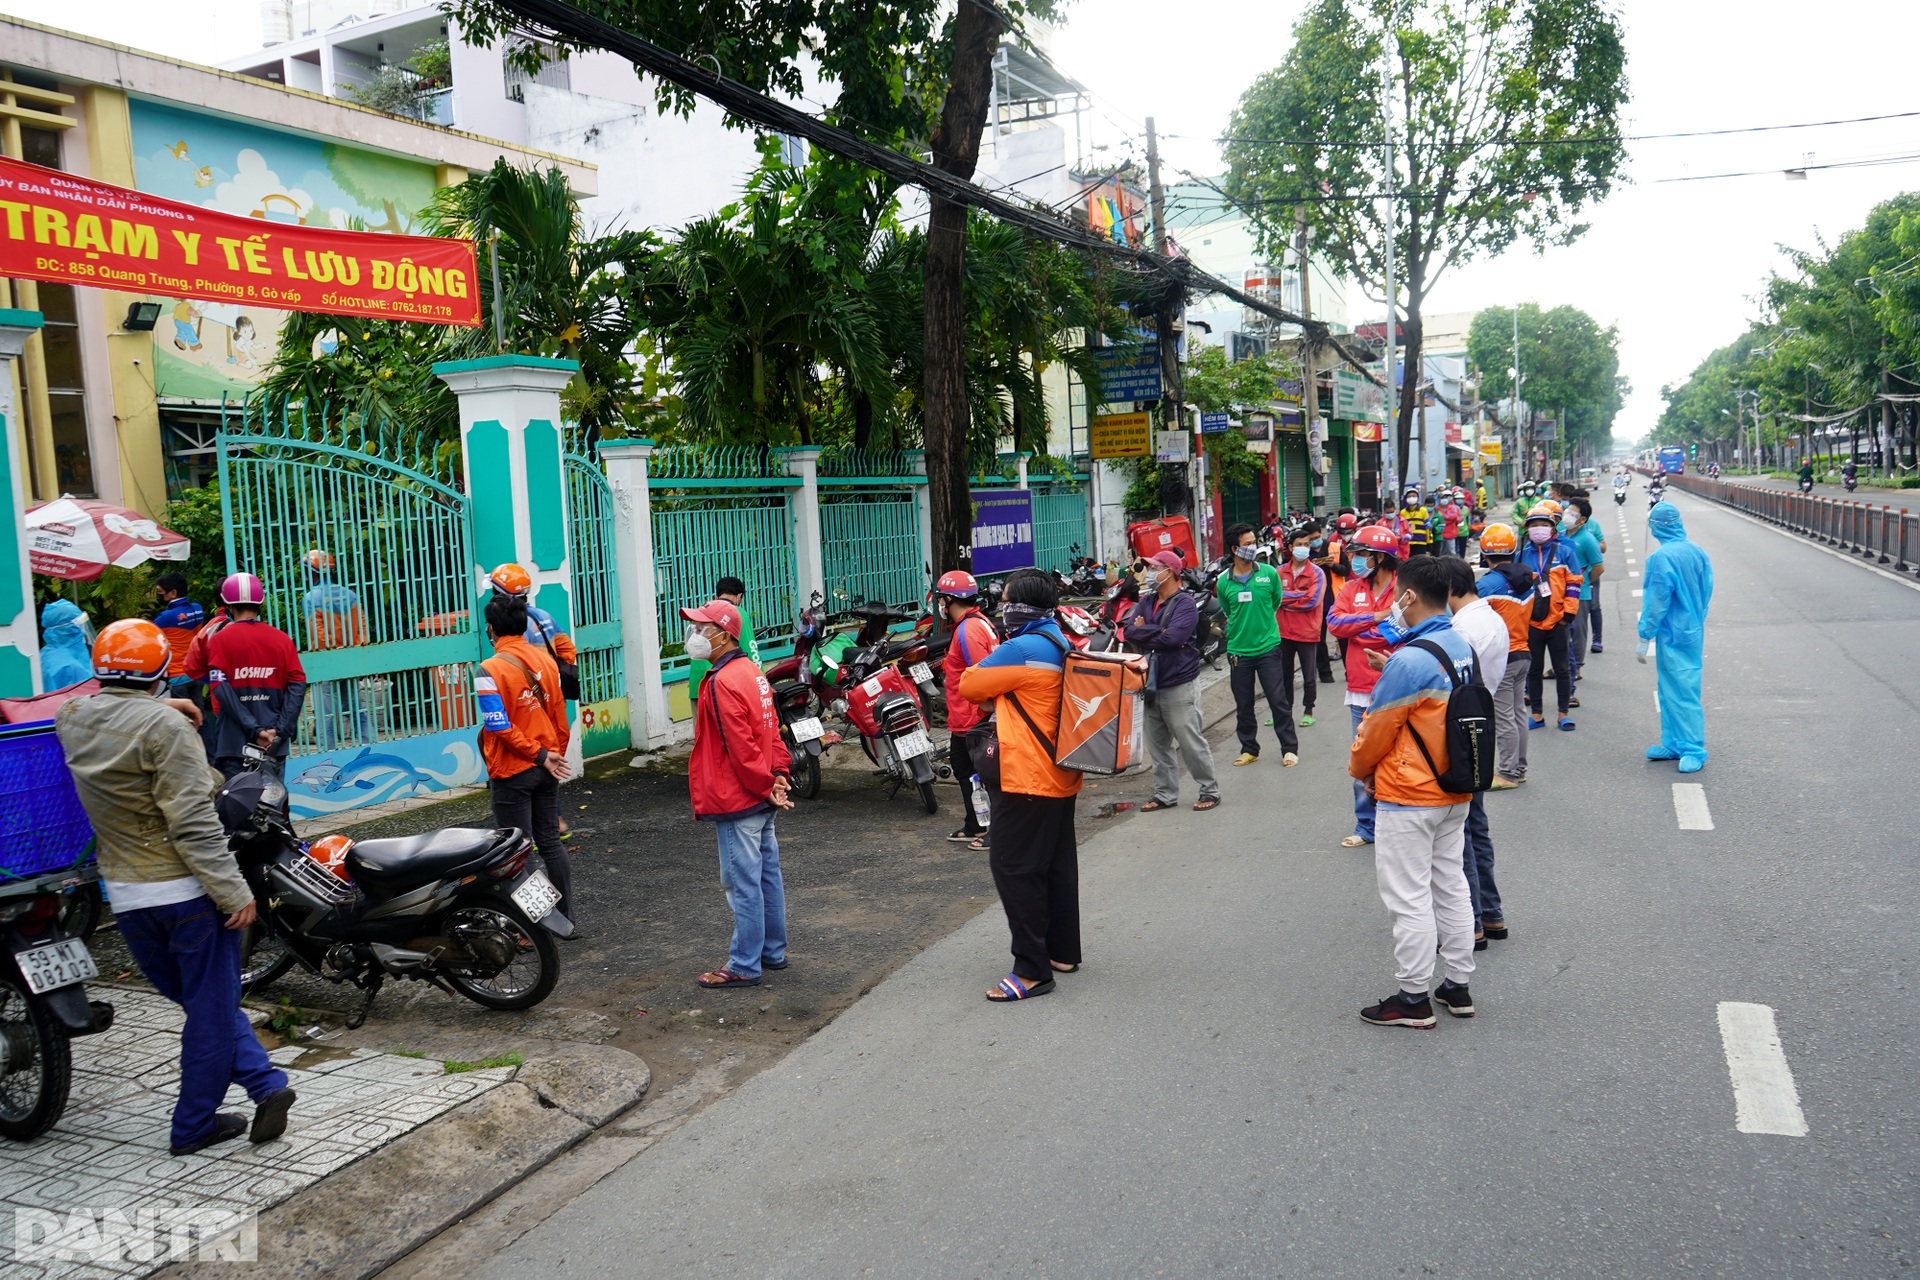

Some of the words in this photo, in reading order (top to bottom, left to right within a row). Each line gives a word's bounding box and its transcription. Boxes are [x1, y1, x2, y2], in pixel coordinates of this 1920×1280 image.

[18, 182, 51, 195] BAN
[54, 189, 93, 205] NHÂN
[97, 194, 126, 210] DÂN
[50, 176, 91, 192] QUẬN
[0, 199, 159, 260] TRẠM
[171, 229, 201, 265] Y
[215, 233, 272, 275] TẾ
[282, 246, 360, 286] LƯU
[371, 258, 468, 299] ĐỘNG
[36, 257, 65, 273] ĐC:
[69, 261, 95, 276] 858
[98, 265, 146, 285] Quang
[149, 272, 193, 291] Trung,
[195, 280, 244, 297] Phường
[247, 286, 258, 298] 8,
[261, 287, 278, 299] Gò
[281, 288, 301, 304] vấp
[321, 291, 338, 306] SỐ
[339, 295, 391, 311] HOTLINE:
[392, 302, 452, 316] 0762.187.178
[958, 545, 972, 558] 36
[234, 666, 278, 679] LOSHIP
